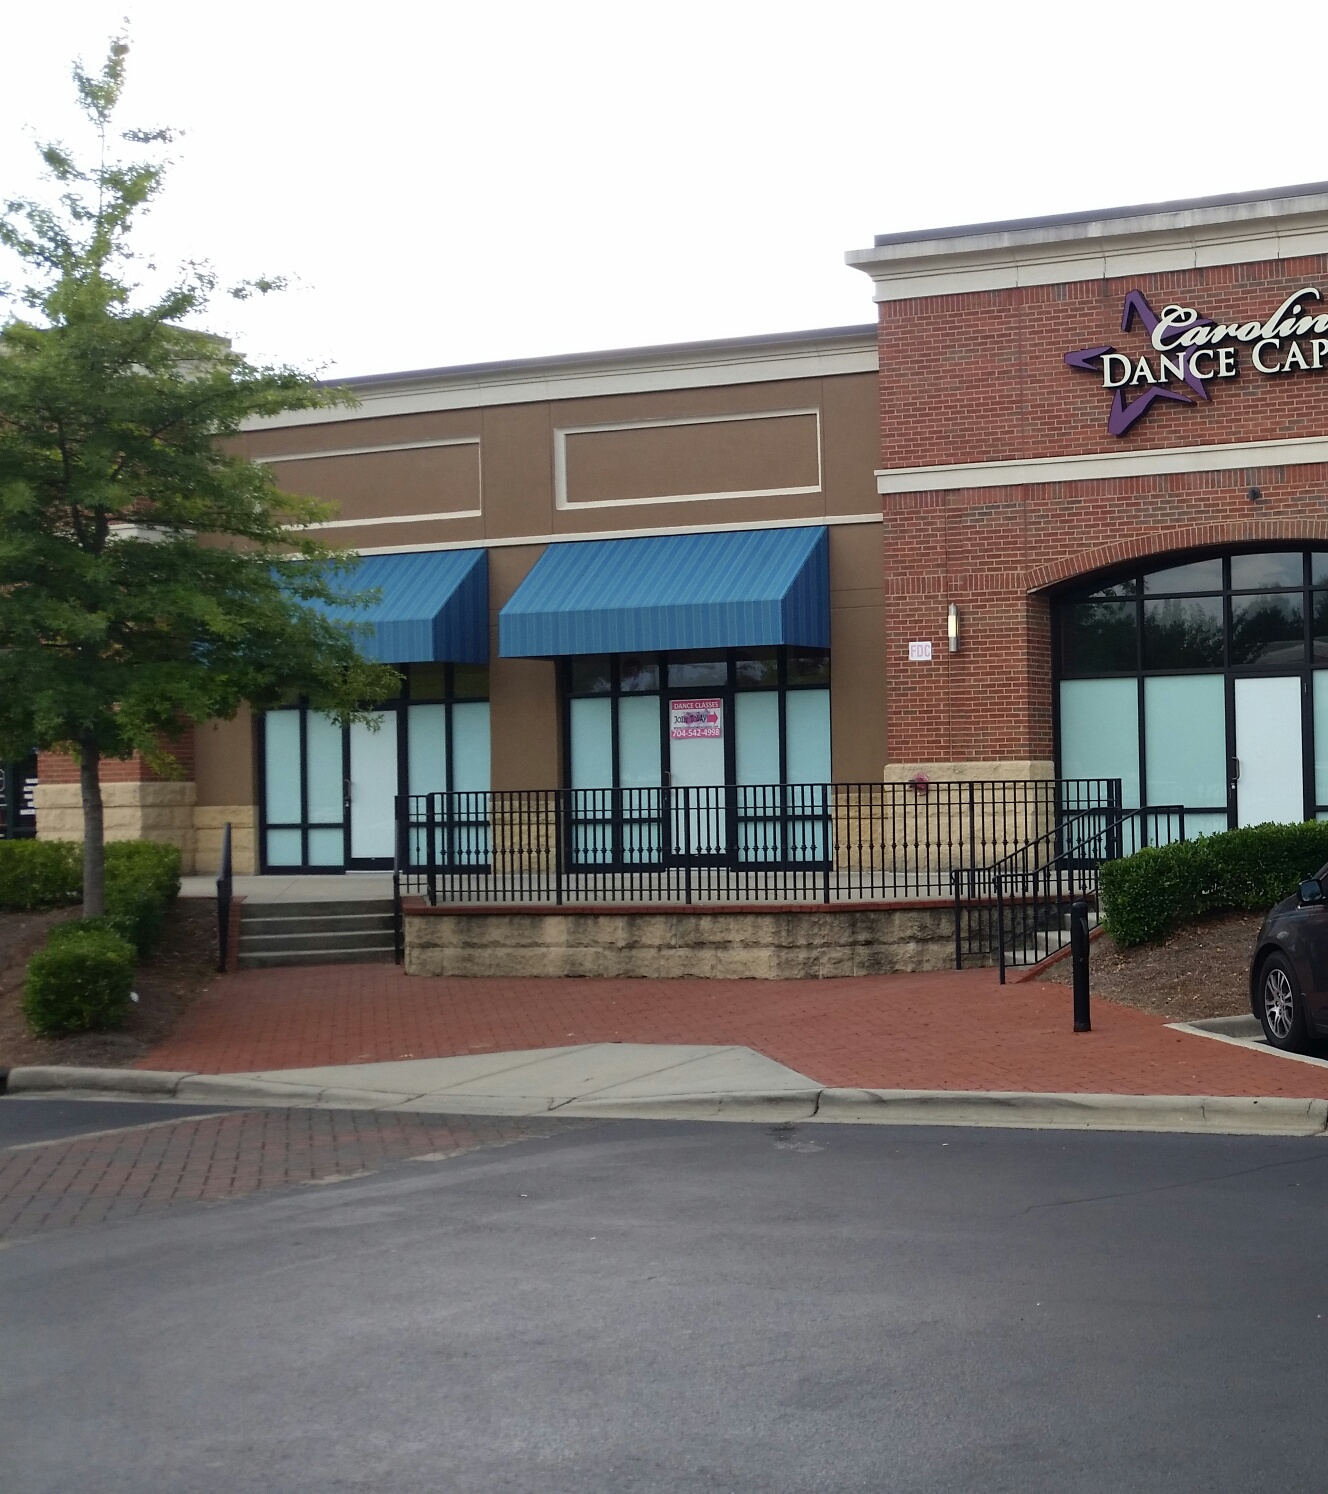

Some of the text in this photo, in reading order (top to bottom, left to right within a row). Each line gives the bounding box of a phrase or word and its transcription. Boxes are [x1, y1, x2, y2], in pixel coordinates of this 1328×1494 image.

[1101, 346, 1237, 389] DANCE
[910, 644, 931, 658] FDC
[672, 729, 720, 737] 704-542-4998
